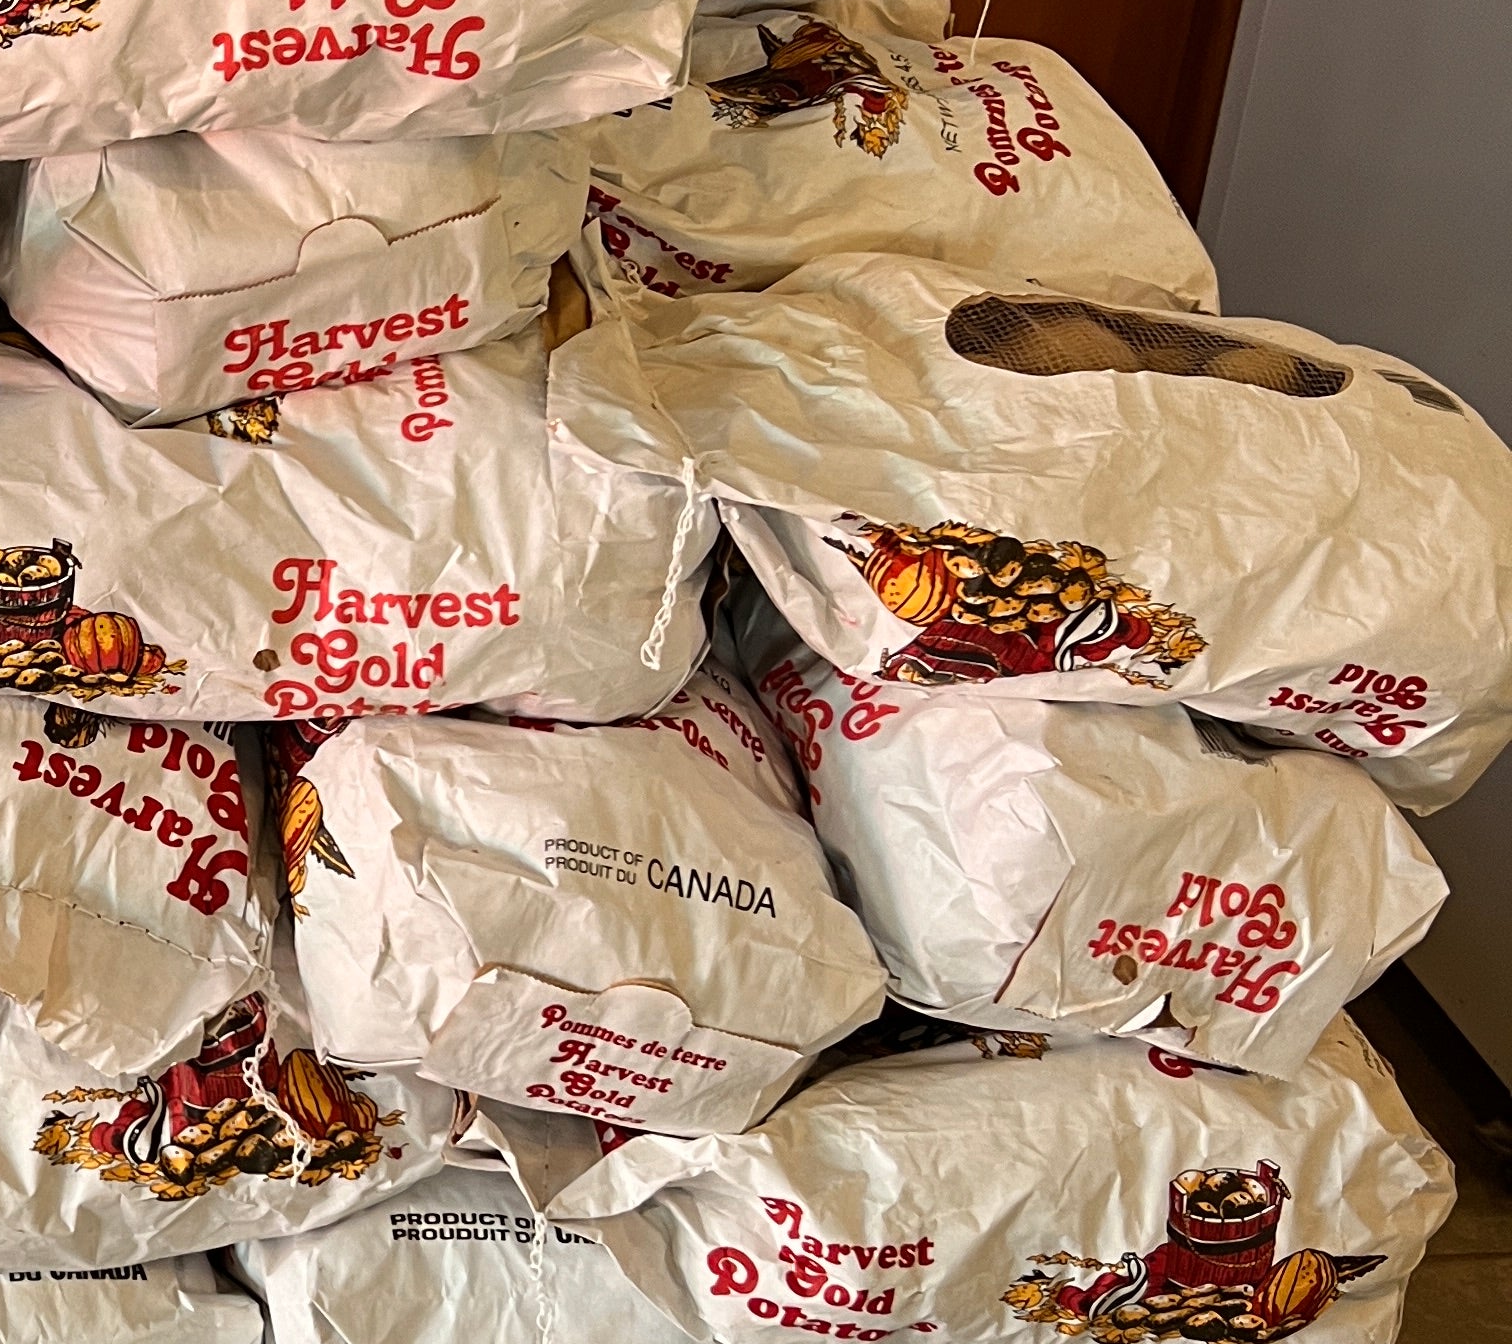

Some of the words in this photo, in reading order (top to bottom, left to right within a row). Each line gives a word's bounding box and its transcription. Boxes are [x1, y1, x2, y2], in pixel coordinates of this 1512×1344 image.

[212, 16, 486, 83] Harvest
[223, 292, 469, 373] Harvest
[271, 557, 521, 632] Harvest
[290, 629, 446, 694] Gold
[1328, 664, 1428, 710] Gold
[1268, 687, 1428, 746] Harvest
[13, 739, 250, 916] Harvest
[544, 838, 621, 863] PRODUCT
[623, 851, 645, 867] OF
[544, 856, 613, 882] PRODUIT
[615, 868, 638, 885] DU
[646, 858, 778, 919] CANADA
[1166, 872, 1297, 951] Gold
[1088, 918, 1301, 1014] Harvest
[541, 1003, 638, 1052] Pommes
[640, 1038, 669, 1059] de
[670, 1044, 728, 1071] terre
[550, 1039, 674, 1095] Harvest
[560, 1069, 637, 1110] Gold
[390, 1212, 509, 1226] PRODUCT
[515, 1216, 536, 1229] O
[392, 1227, 511, 1241] PROUDUIT
[758, 1195, 935, 1270] Harvest
[778, 1245, 896, 1315] Gold
